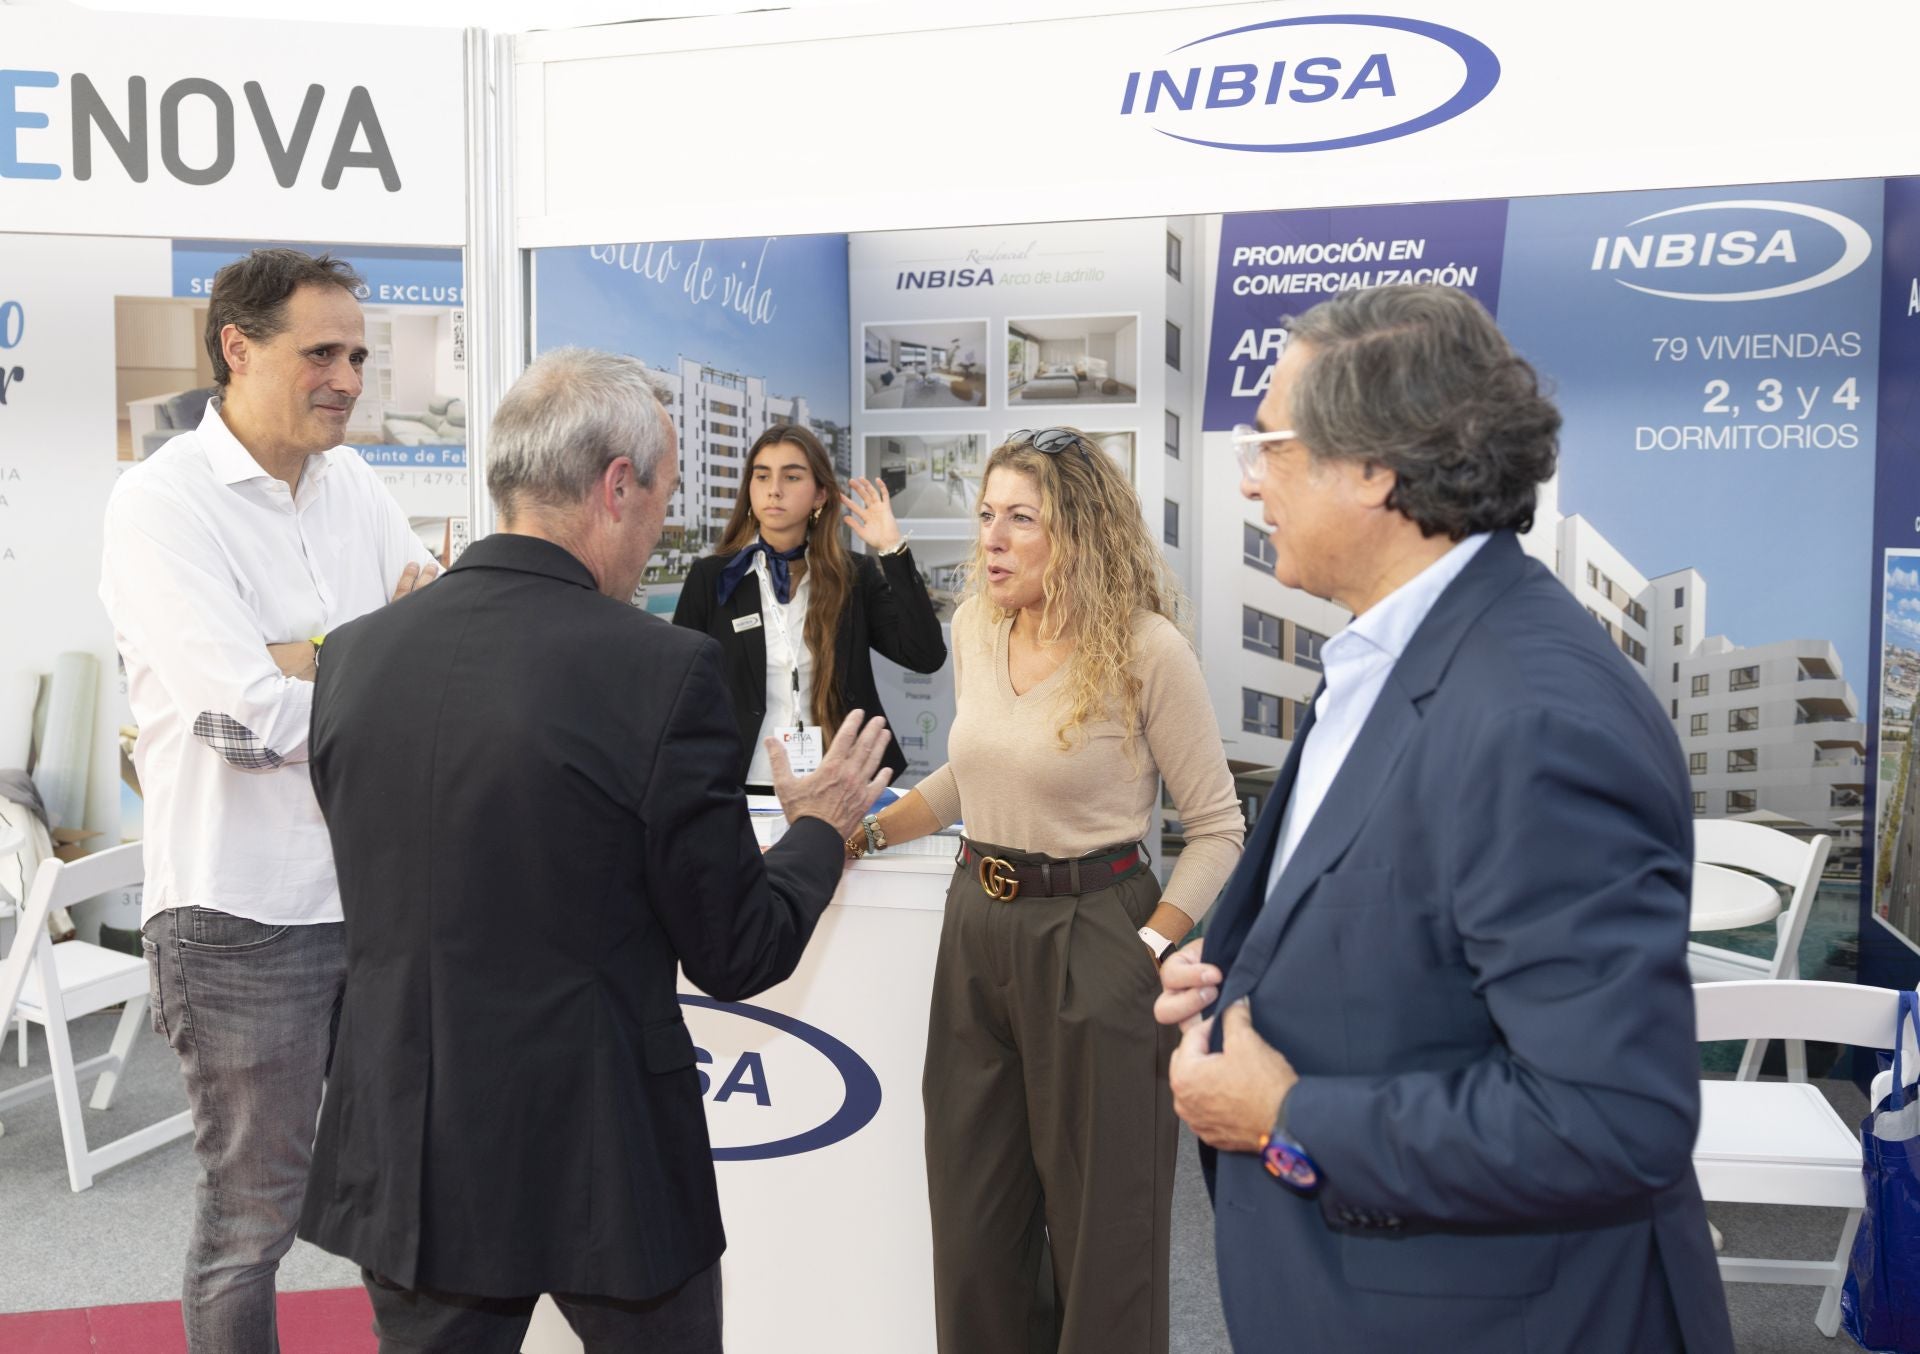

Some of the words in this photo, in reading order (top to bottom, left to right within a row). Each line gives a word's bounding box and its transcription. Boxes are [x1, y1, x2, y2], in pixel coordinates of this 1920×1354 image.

[1120, 53, 1397, 115] INBISA
[0, 69, 402, 192] ENOVA
[1232, 237, 1386, 267] PROMOCIÓN
[1388, 239, 1425, 260] EN
[1591, 229, 1797, 270] INBISA
[684, 240, 717, 304] de
[721, 236, 777, 325] vida
[896, 268, 994, 290] INBISA
[999, 272, 1031, 287] Arco
[1034, 268, 1052, 284] de
[1055, 265, 1105, 284] Ladrillo
[1232, 263, 1478, 296] COMERCIALIZACIÓN
[1652, 338, 1688, 361] 79
[1697, 332, 1862, 360] VIVIENDAS
[1703, 379, 1740, 418] 2,
[1756, 378, 1784, 412] 3
[1796, 386, 1820, 419] y
[1832, 377, 1860, 411] 4
[1635, 424, 1859, 451] DORMITORIOS
[415, 449, 435, 462] de
